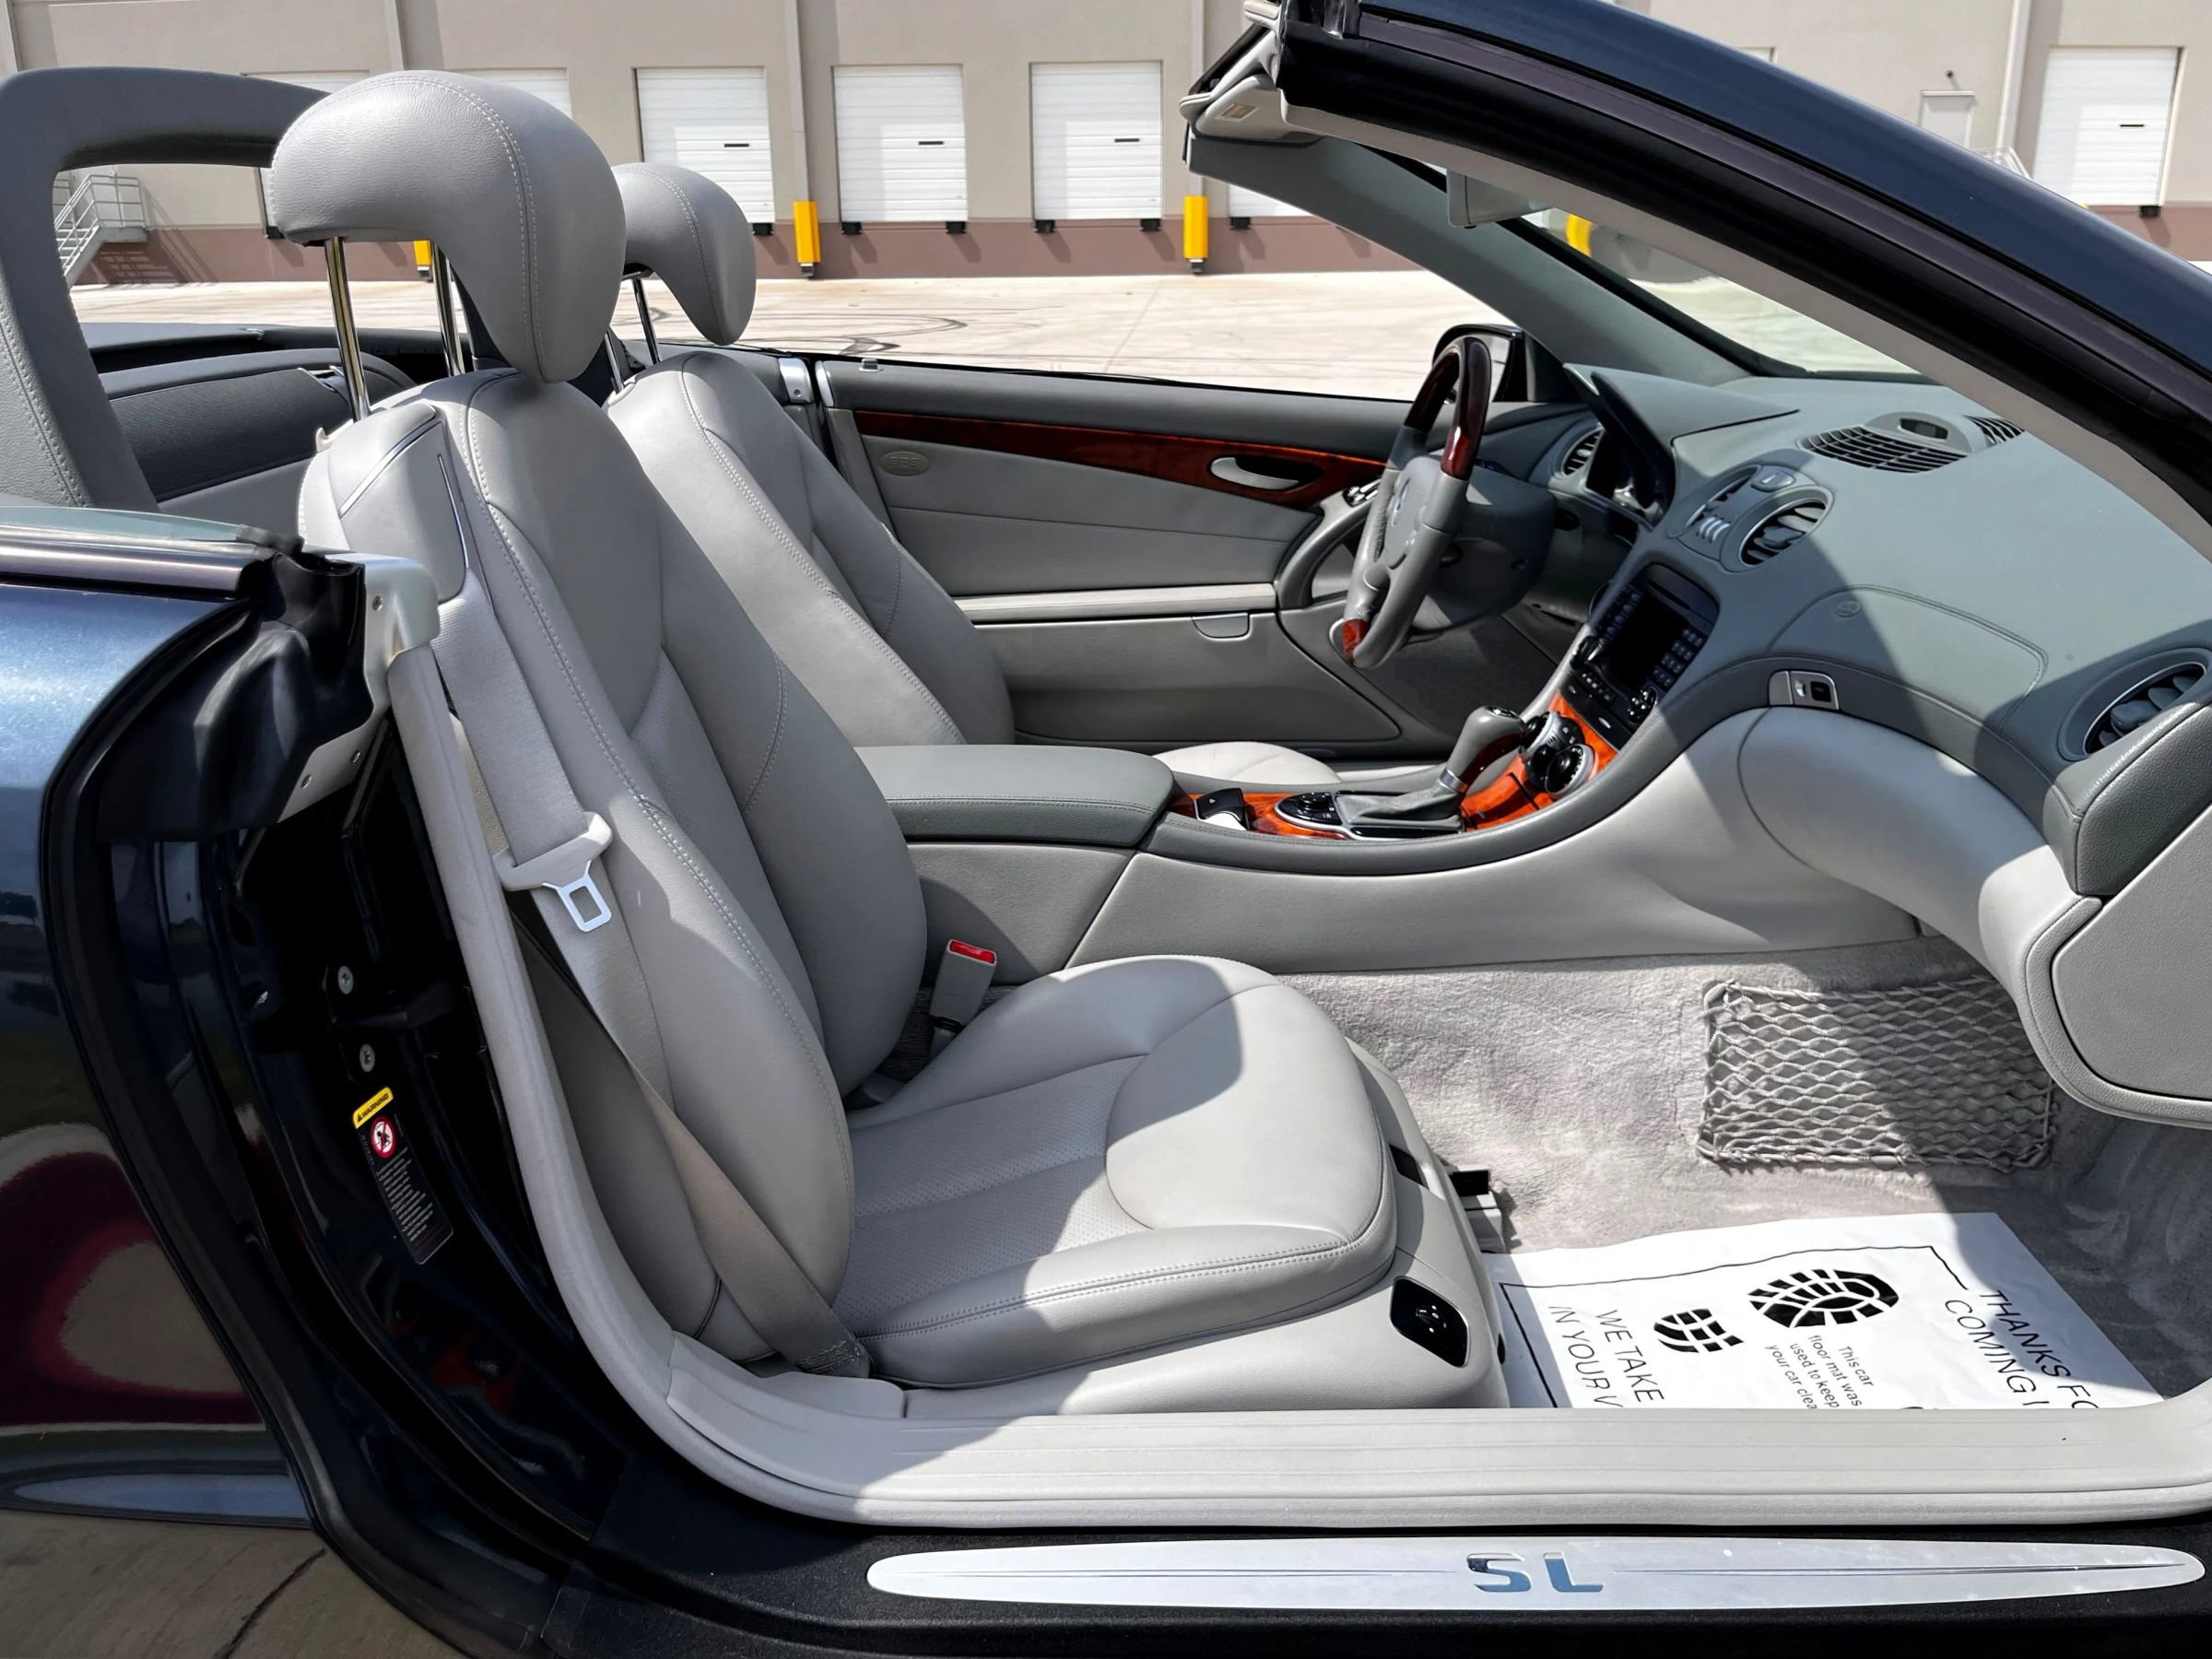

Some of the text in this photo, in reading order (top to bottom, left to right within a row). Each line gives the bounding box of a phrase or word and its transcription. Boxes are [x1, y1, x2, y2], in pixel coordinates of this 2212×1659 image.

[360, 1092, 389, 1118] WARNING
[1547, 1306, 1624, 1407] IN YOUR V
[1595, 1310, 1665, 1403] WE TAKE
[1839, 1347, 1875, 1386] This car
[1945, 1300, 2037, 1393] COMING
[1979, 1290, 2072, 1377] THANKS
[1764, 1345, 1818, 1409] your car clea
[1789, 1343, 1840, 1408] used to keep
[1807, 1335, 1863, 1406] floor mat was
[1466, 1552, 1606, 1593] SL
